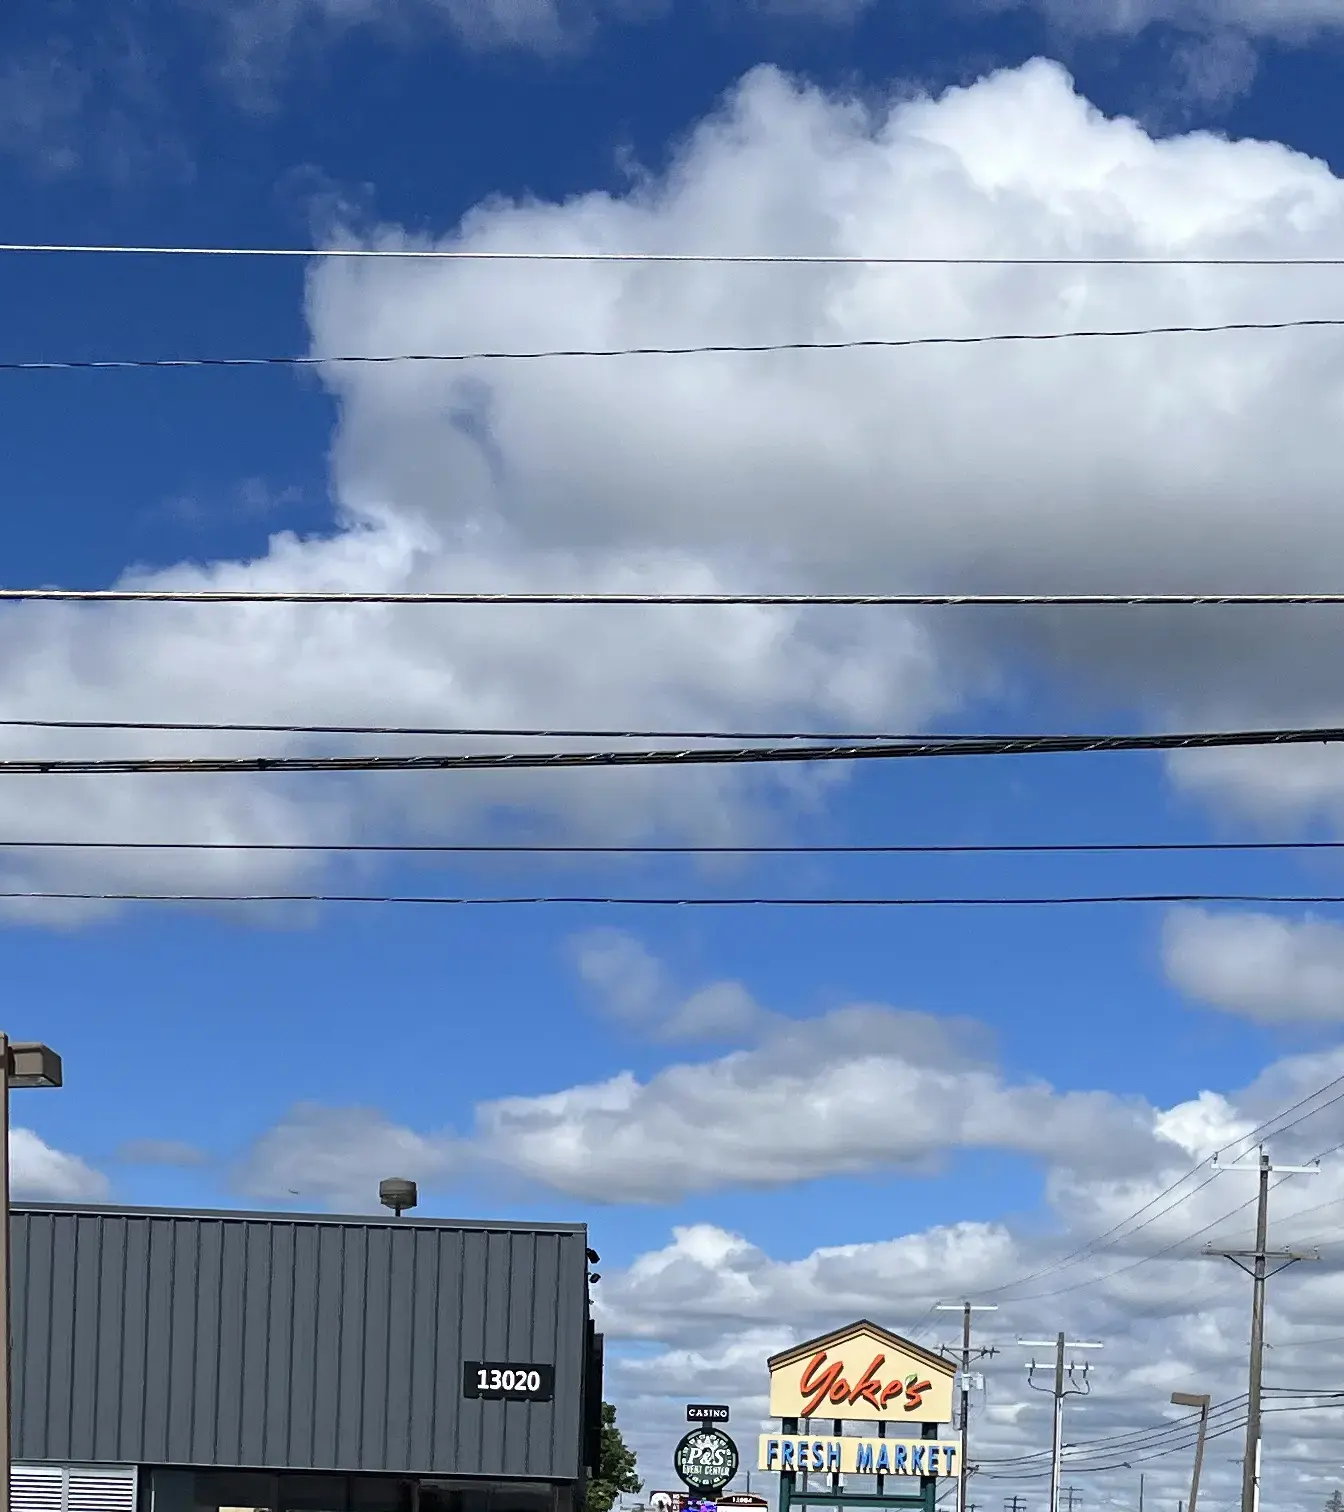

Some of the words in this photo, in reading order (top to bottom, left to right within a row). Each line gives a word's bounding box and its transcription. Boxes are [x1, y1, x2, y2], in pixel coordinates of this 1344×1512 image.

[477, 1369, 541, 1391] 13020
[800, 1350, 932, 1417] Yoke's
[688, 1409, 728, 1418] CASINO
[766, 1439, 842, 1472] FRESH
[856, 1442, 957, 1477] MARKET
